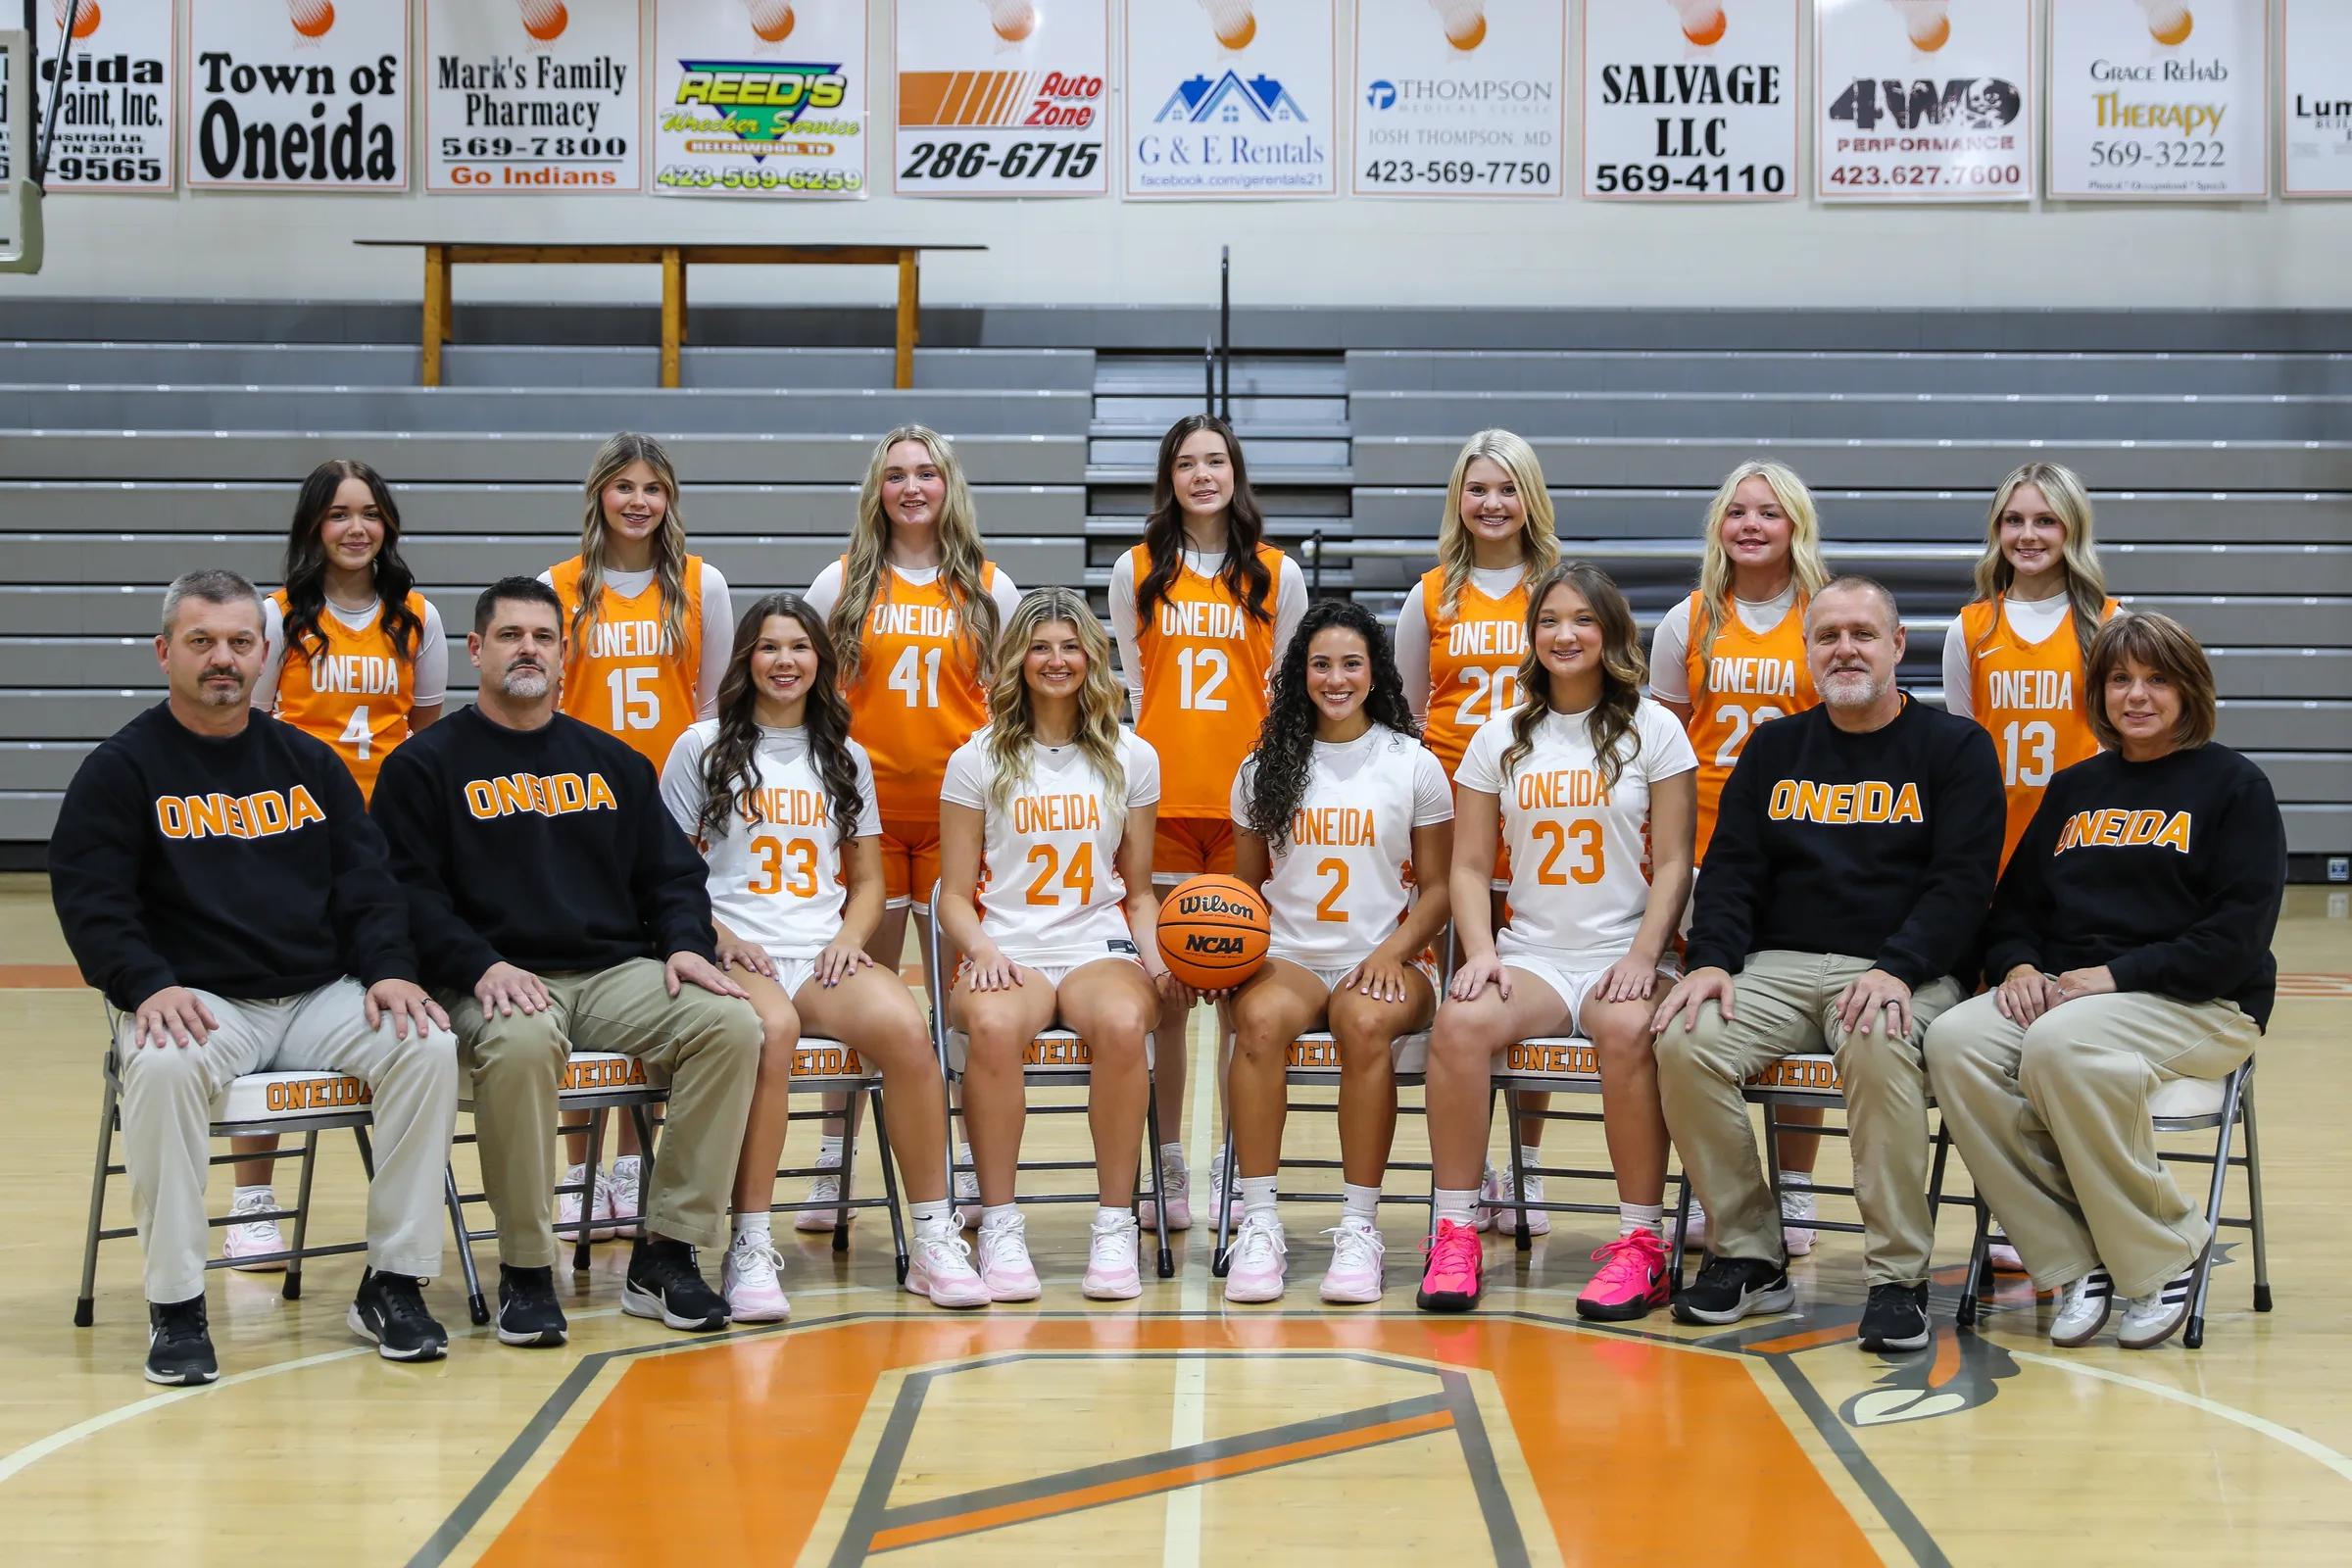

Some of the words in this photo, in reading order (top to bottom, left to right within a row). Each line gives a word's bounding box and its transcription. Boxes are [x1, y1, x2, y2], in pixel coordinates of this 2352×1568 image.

[41, 53, 164, 84] eida
[199, 52, 336, 95] Town
[350, 54, 397, 95] of
[439, 55, 526, 90] Mark's
[537, 57, 627, 95] Family
[1039, 72, 1104, 99] Auto
[1602, 65, 1780, 105] SALVAGE
[60, 86, 116, 128] aint,
[122, 86, 163, 126] Inc.
[675, 71, 847, 108] REED'S
[1398, 79, 1552, 101] THOMPSON
[466, 93, 600, 132] Pharmacy
[660, 109, 760, 133] Wrecker
[769, 110, 860, 135] Service
[1024, 101, 1095, 127] Zone
[200, 99, 396, 180] Oneida
[442, 137, 626, 157] 569-7800
[1139, 135, 1159, 165] G
[1170, 136, 1190, 165] &
[1202, 135, 1221, 164] E
[1231, 134, 1324, 165] Rentals
[1368, 129, 1408, 145] JOSH
[1523, 130, 1552, 145] MD
[1655, 118, 1726, 158] LLC
[1838, 136, 2015, 152] PERFORMANCE
[2089, 140, 2227, 169] 569-3222
[451, 168, 491, 184] Go
[504, 167, 616, 184] Indians
[658, 165, 863, 191] 423-569-6259
[901, 142, 1102, 178] 286-6715
[1366, 161, 1550, 184] 423-569-7750
[1596, 165, 1785, 192] 569-4110
[1831, 166, 2021, 185] 423.627.7600
[872, 603, 958, 639] ONEIDA
[1161, 602, 1246, 640] ONEIDA
[1448, 620, 1530, 657] ONEIDA
[311, 655, 399, 695] ONEIDA
[888, 645, 942, 708] 41
[1177, 647, 1229, 711] 12
[1707, 657, 1795, 698] ONEIDA
[1988, 669, 2074, 710] ONEIDA
[607, 666, 661, 731] 15
[1454, 665, 1525, 725] 20
[338, 705, 373, 760] 4
[2003, 720, 2056, 787] 13
[465, 772, 618, 820] ONEIDA
[741, 787, 828, 828] ONEIDA
[1518, 768, 1611, 810] ONEIDA
[1767, 778, 1924, 825] ONEIDA
[155, 784, 326, 840] ONEIDA
[1013, 794, 1101, 835] ONEIDA
[1293, 808, 1376, 847] ONEIDA
[1532, 818, 1605, 886] 23
[2054, 808, 2191, 857] ONEIDA
[748, 835, 819, 899] 33
[1025, 842, 1096, 906] 24
[1179, 895, 1255, 921] Wilson
[1316, 858, 1349, 922] 2
[1184, 934, 1244, 954] NCAA
[790, 1048, 862, 1076] EIDA
[1022, 1039, 1094, 1065] NEID
[1507, 1044, 1601, 1074] ONEID
[557, 1057, 648, 1090] NEIDA
